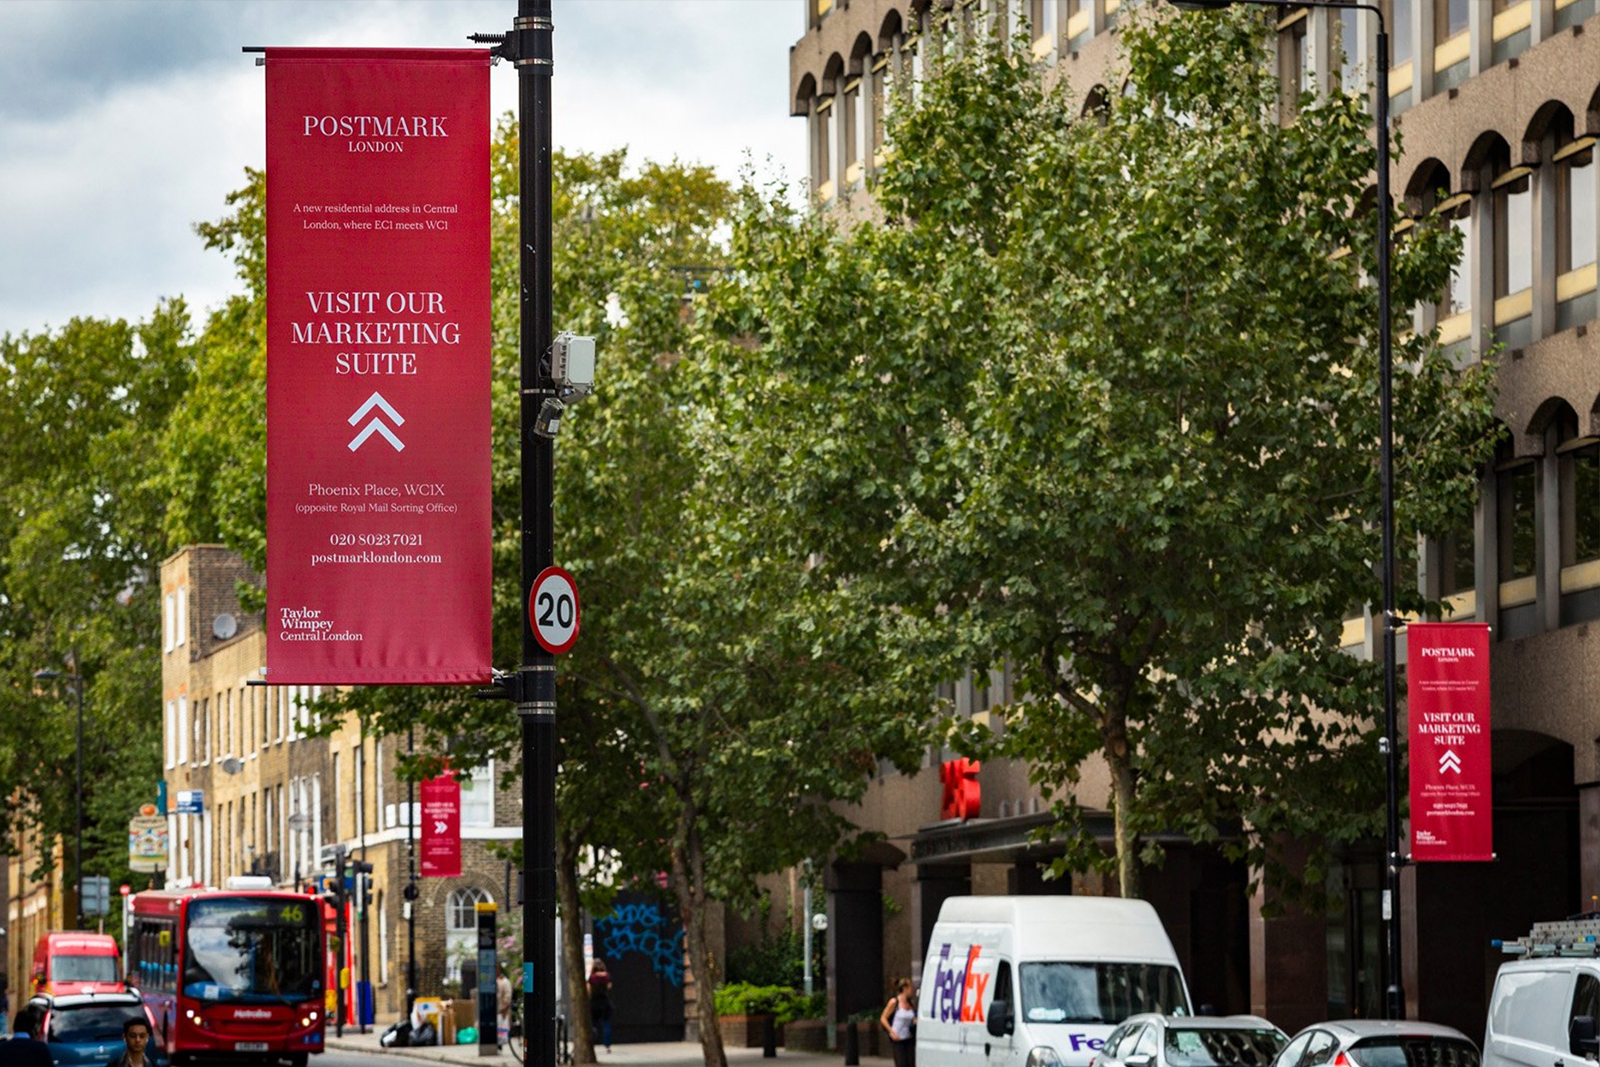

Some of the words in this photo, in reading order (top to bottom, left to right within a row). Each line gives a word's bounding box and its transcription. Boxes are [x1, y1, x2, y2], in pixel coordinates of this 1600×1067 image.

[303, 115, 449, 138] POSTMARK
[348, 141, 404, 153] LONDON
[293, 203, 301, 213] A
[303, 205, 322, 213] new
[325, 203, 372, 213] residential
[375, 203, 410, 213] address
[412, 203, 422, 213] in
[423, 203, 458, 214] Central
[303, 219, 341, 230] London,
[343, 219, 372, 230] where
[375, 219, 393, 230] EC1
[396, 221, 424, 230] meets
[426, 220, 448, 230] WC1
[306, 292, 380, 314] VISIT
[387, 292, 446, 315] OUR
[291, 322, 462, 345] MARKETING
[335, 352, 417, 375] SUITE
[309, 483, 360, 496] Phoenix
[364, 483, 402, 497] Place,
[295, 503, 338, 514] (opposite
[340, 503, 366, 514] Royal
[369, 503, 388, 513] Mail
[390, 503, 424, 514] Sorting
[426, 502, 458, 514] Office)
[329, 533, 356, 546] 020
[359, 533, 390, 546] 8023
[393, 533, 422, 546] 7021
[311, 551, 442, 567] postmarklondon.com
[280, 607, 321, 619] Taylor
[538, 592, 573, 629] 20
[281, 618, 334, 632] Wimpey
[280, 631, 320, 642] Central
[322, 631, 363, 642] London
[1421, 647, 1475, 657] POSTMARK
[1423, 712, 1451, 723] VISIT
[1452, 712, 1475, 722] OUR
[1418, 723, 1481, 735] MARKETING
[1434, 735, 1465, 746] SUITE
[280, 905, 303, 923] 46
[931, 943, 990, 1024] FedEx
